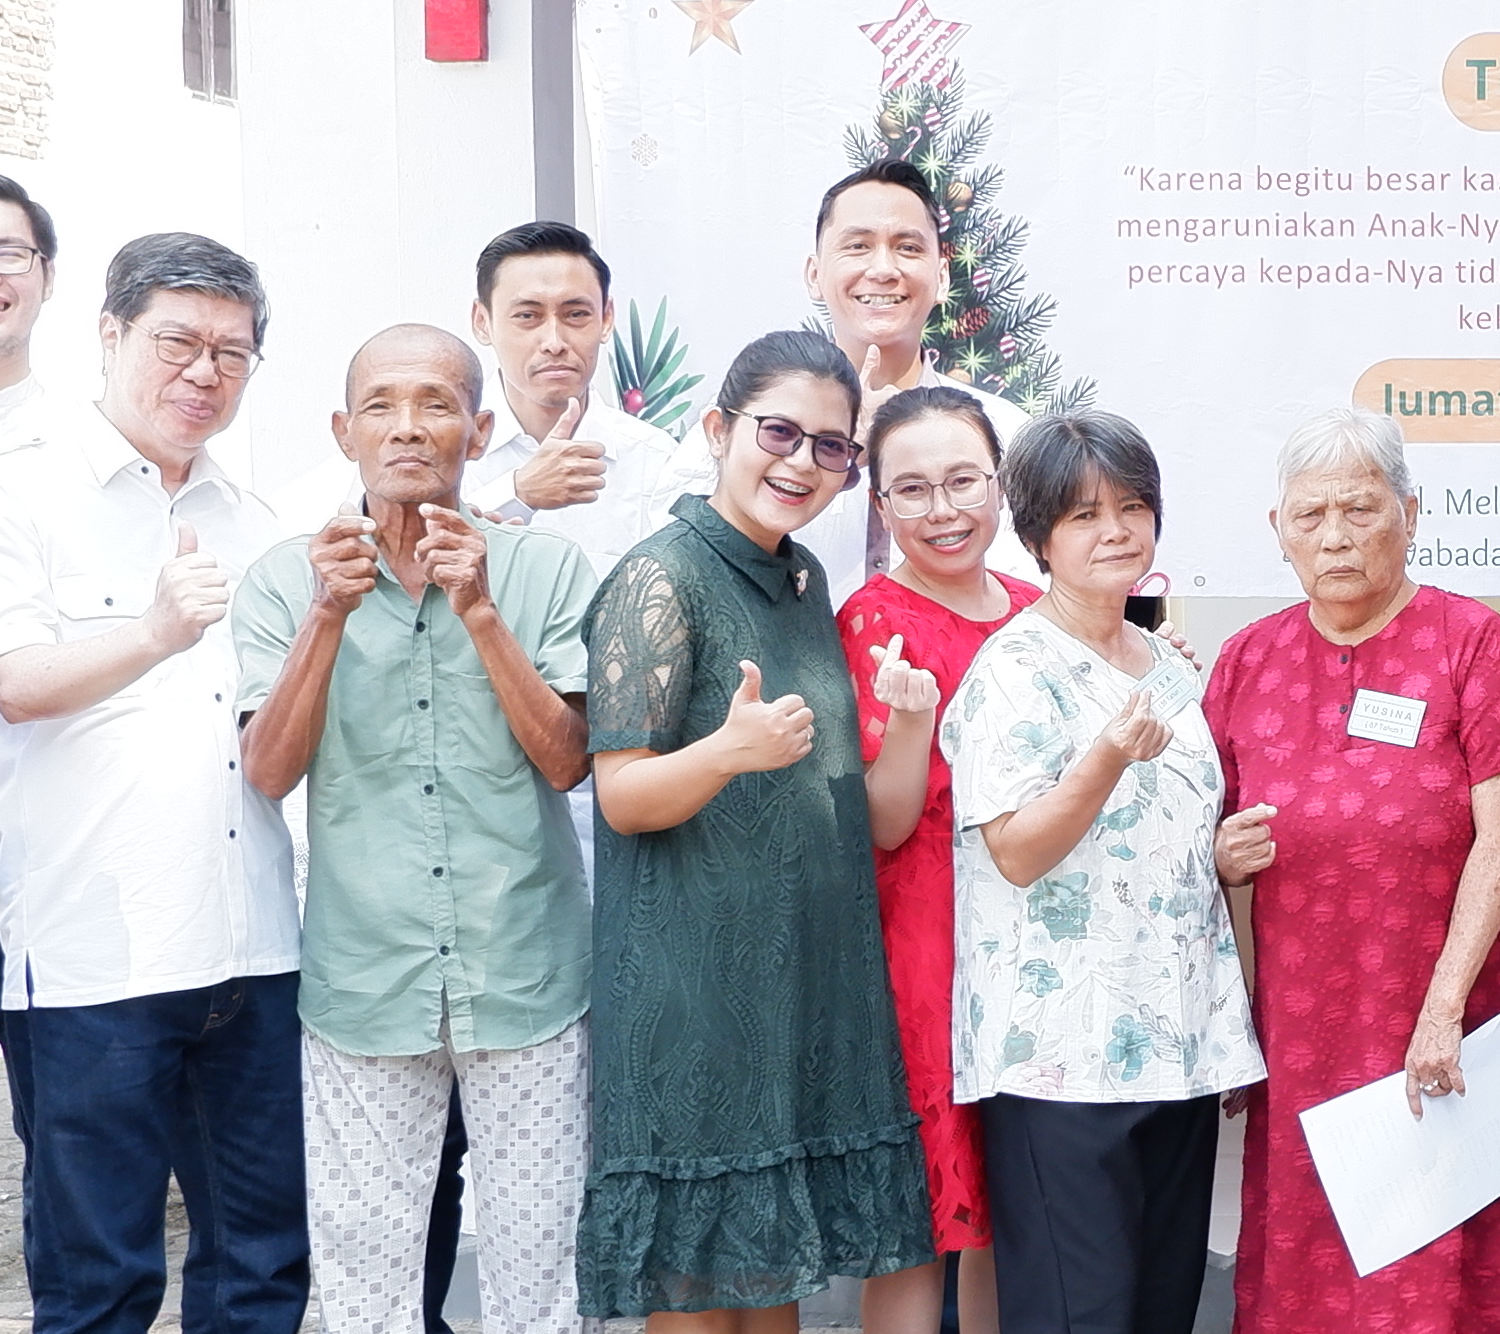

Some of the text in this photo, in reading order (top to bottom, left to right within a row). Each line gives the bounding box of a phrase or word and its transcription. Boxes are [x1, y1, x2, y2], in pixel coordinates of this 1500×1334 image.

[1123, 165, 1242, 192] “Karena
[1256, 164, 1353, 198] begitu
[1366, 165, 1452, 192] besar
[1117, 210, 1355, 243] mengaruniakan
[1128, 264, 1245, 290] percaya
[1260, 257, 1443, 290] kepada-Nya
[1363, 703, 1413, 722] YUSINA
